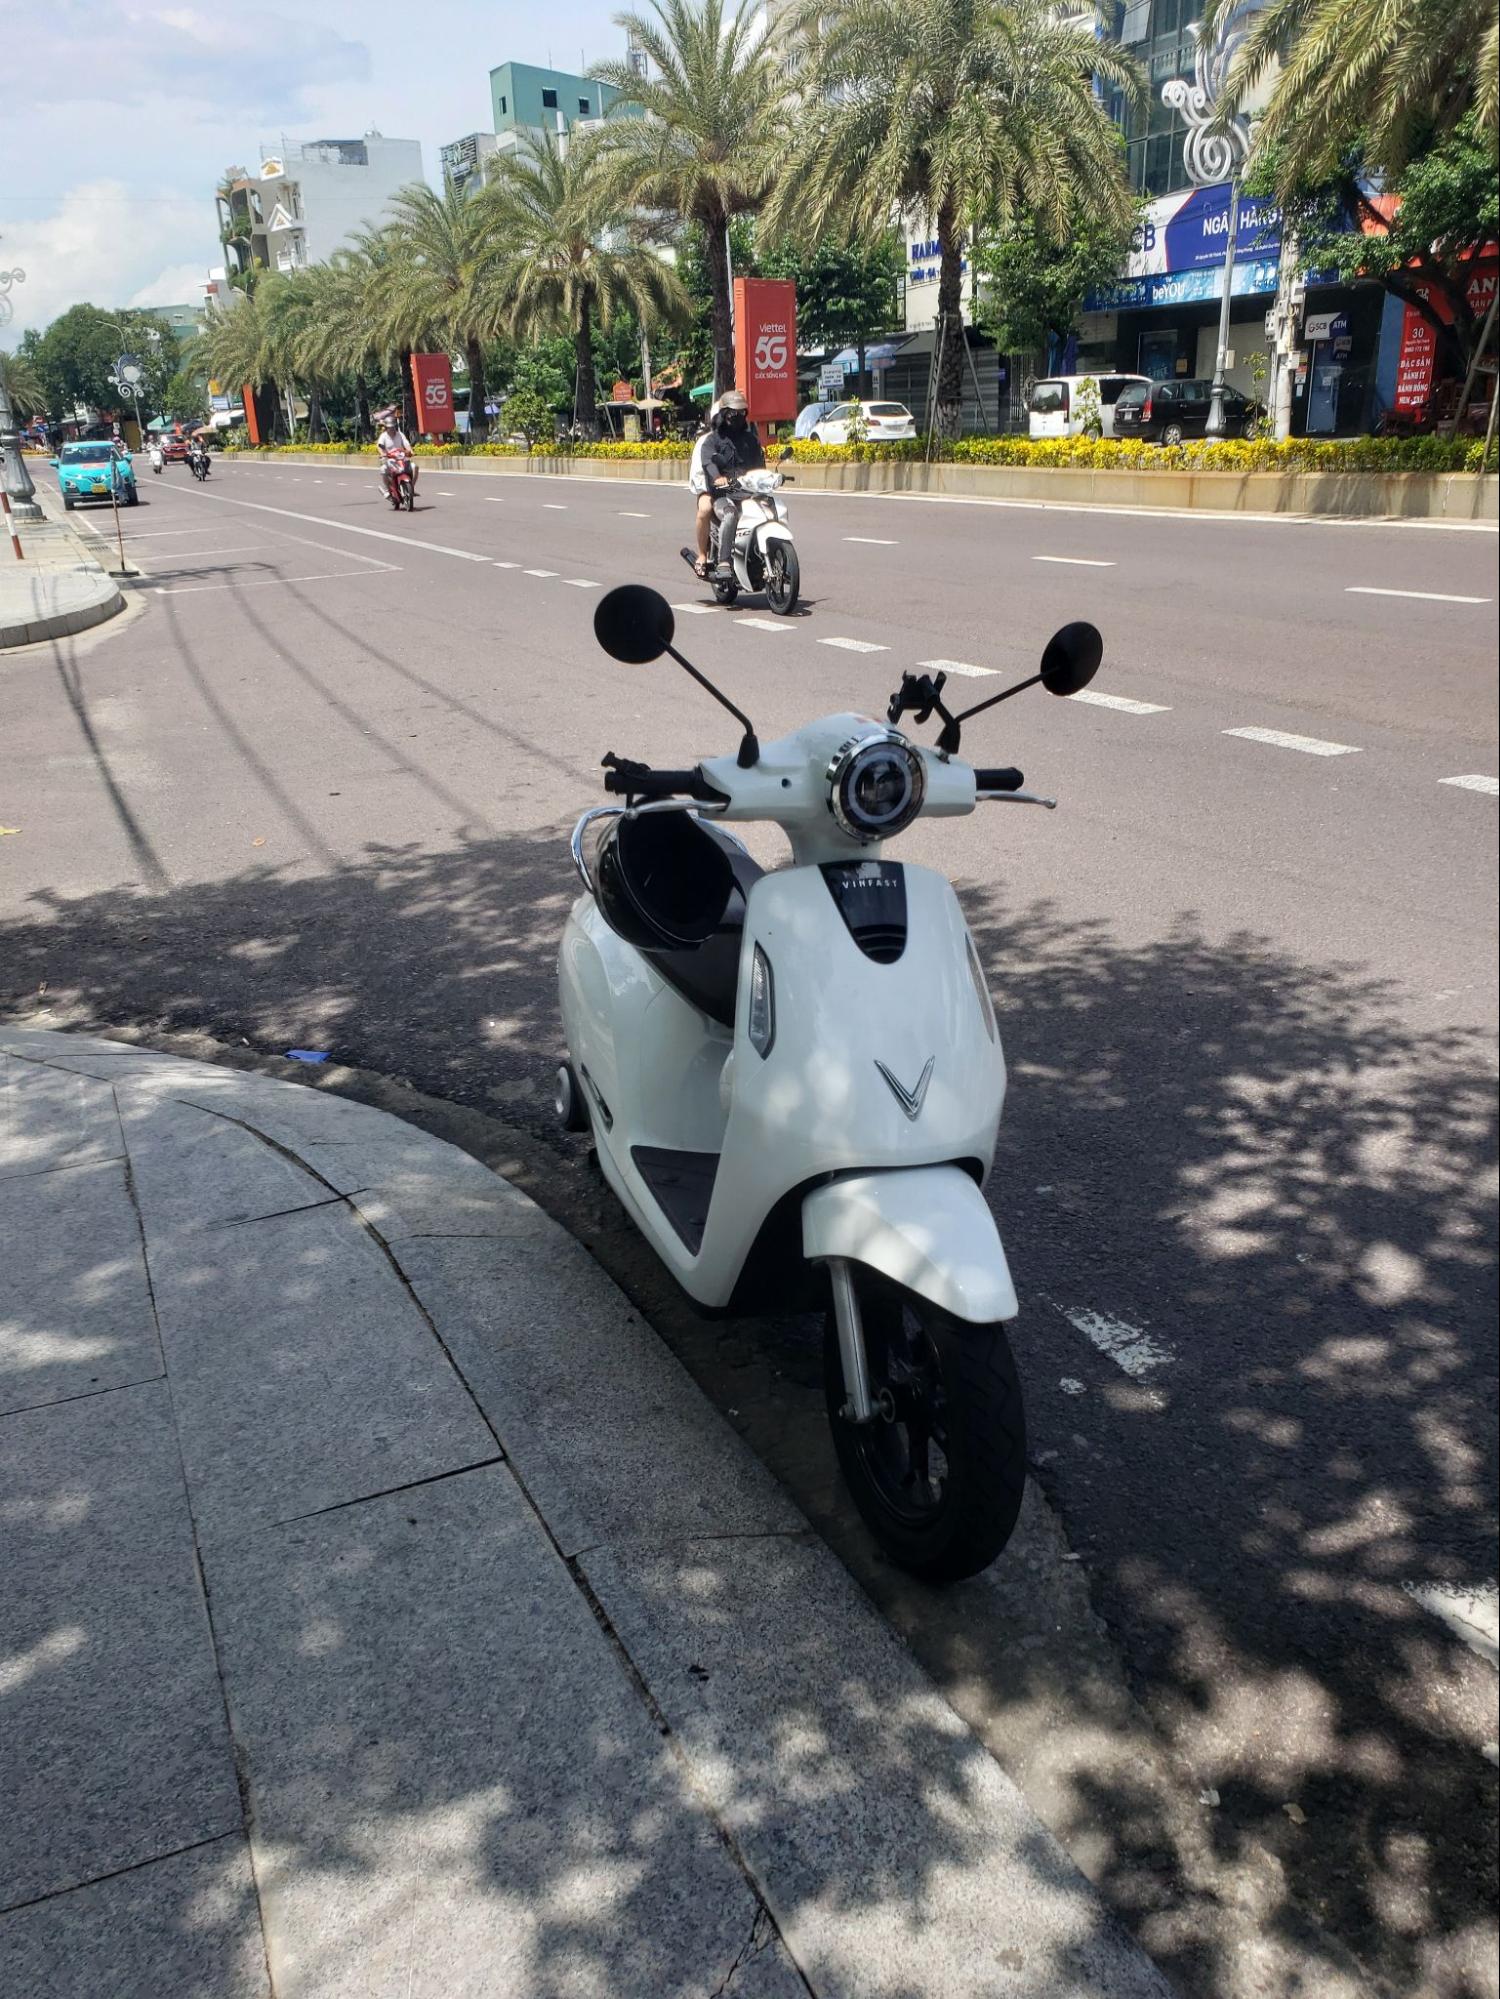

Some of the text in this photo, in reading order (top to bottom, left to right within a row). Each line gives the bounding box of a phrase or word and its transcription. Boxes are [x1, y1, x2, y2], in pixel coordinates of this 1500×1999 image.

[1203, 211, 1229, 236] NGÂ
[760, 323, 787, 333] viettel
[1333, 320, 1347, 329] ATM
[1412, 327, 1425, 339] 30
[755, 336, 787, 370] 5G
[426, 385, 447, 404] 5G
[842, 879, 897, 889] VINFAST
